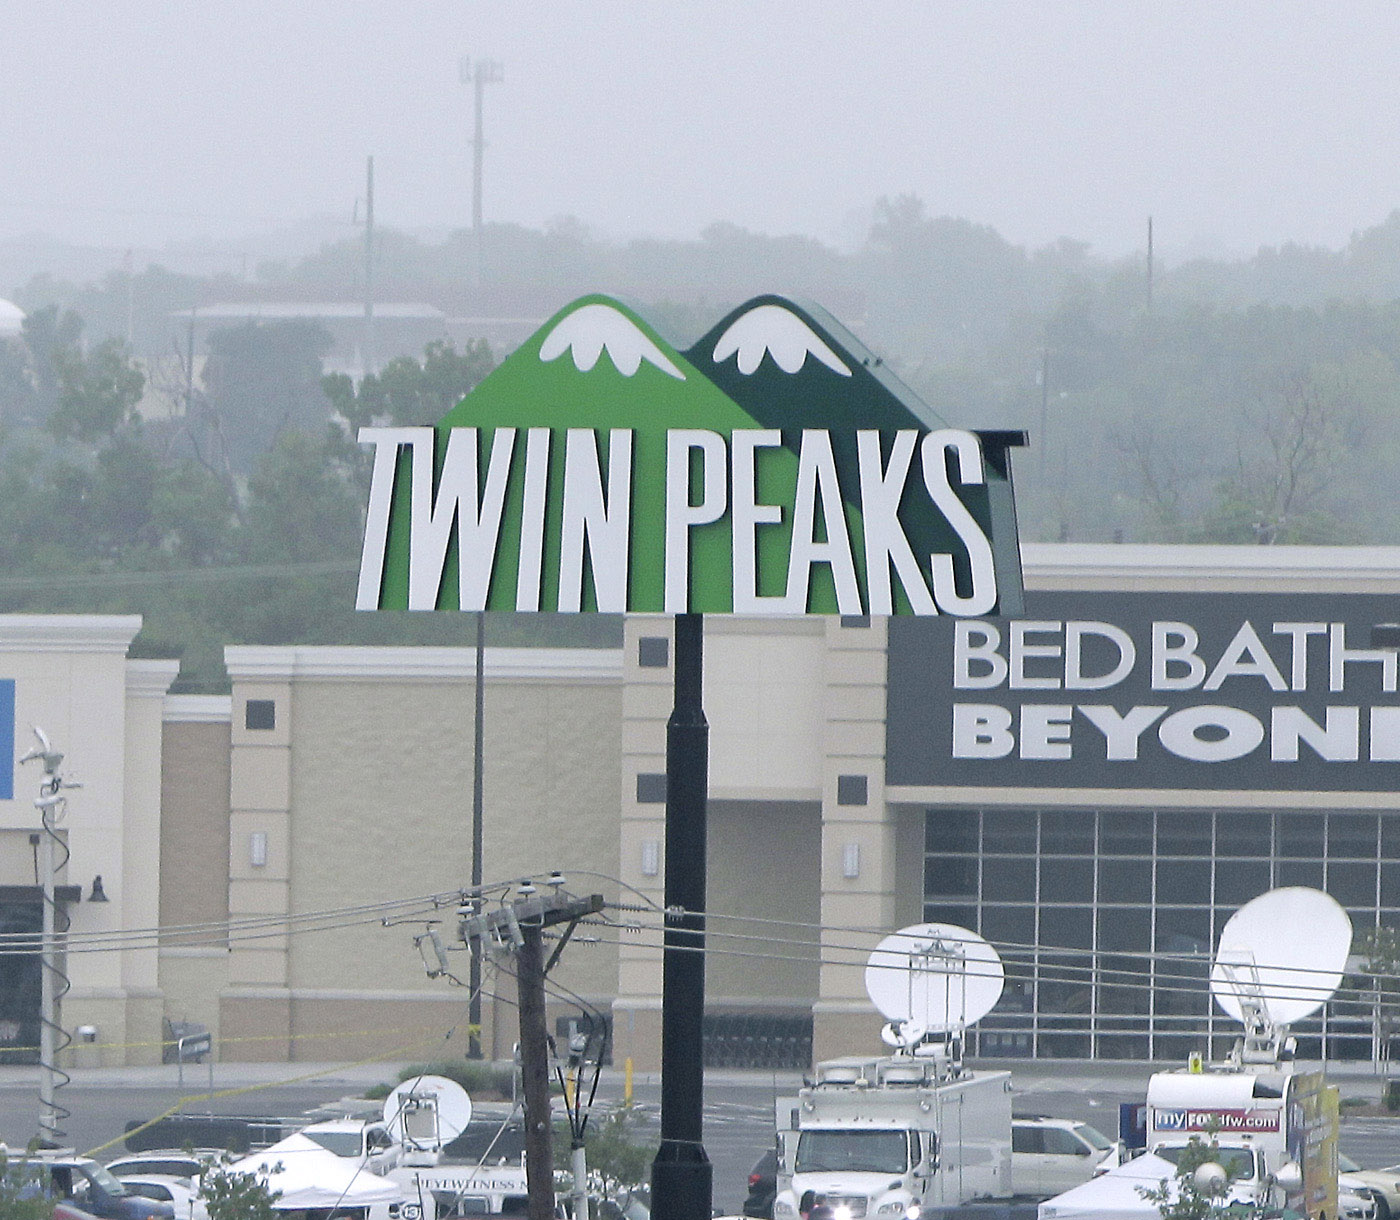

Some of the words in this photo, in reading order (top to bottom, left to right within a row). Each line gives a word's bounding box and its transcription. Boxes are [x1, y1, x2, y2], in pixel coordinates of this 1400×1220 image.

[355, 426, 634, 614] TWIN
[665, 428, 999, 617] PEAKS
[952, 620, 1136, 691] BED
[1150, 620, 1398, 692] BATH
